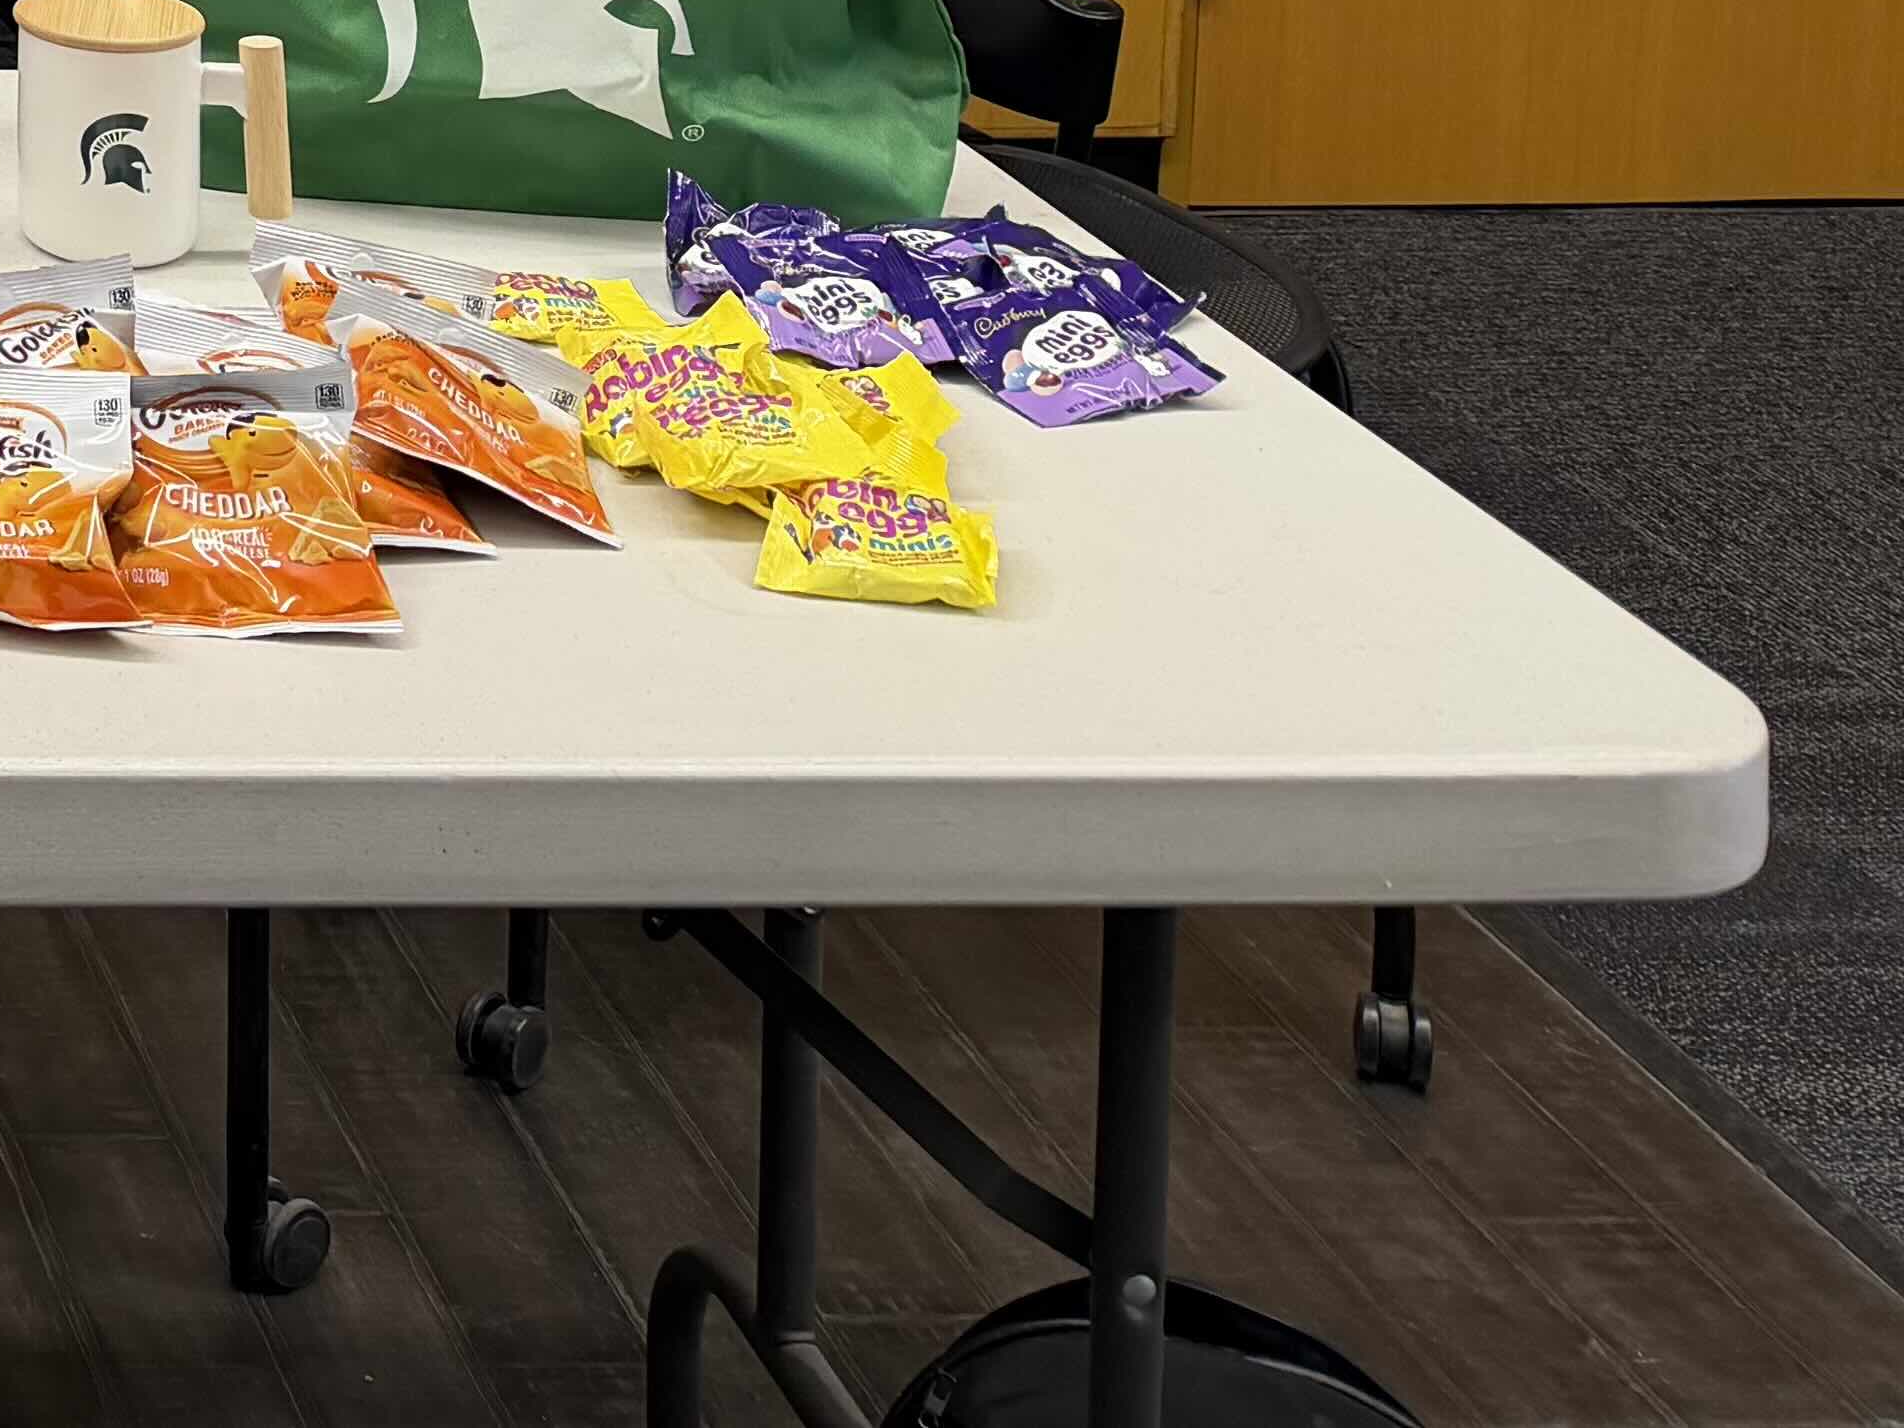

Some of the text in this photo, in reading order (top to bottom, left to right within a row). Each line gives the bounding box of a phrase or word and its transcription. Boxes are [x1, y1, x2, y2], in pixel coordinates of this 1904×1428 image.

[973, 307, 1047, 339] Cadbury
[1035, 314, 1091, 354] mini
[1052, 320, 1115, 364] eggs
[97, 399, 119, 413] 130
[319, 384, 340, 396] 130
[163, 484, 293, 521] CHEDDAR
[868, 532, 953, 552] minis
